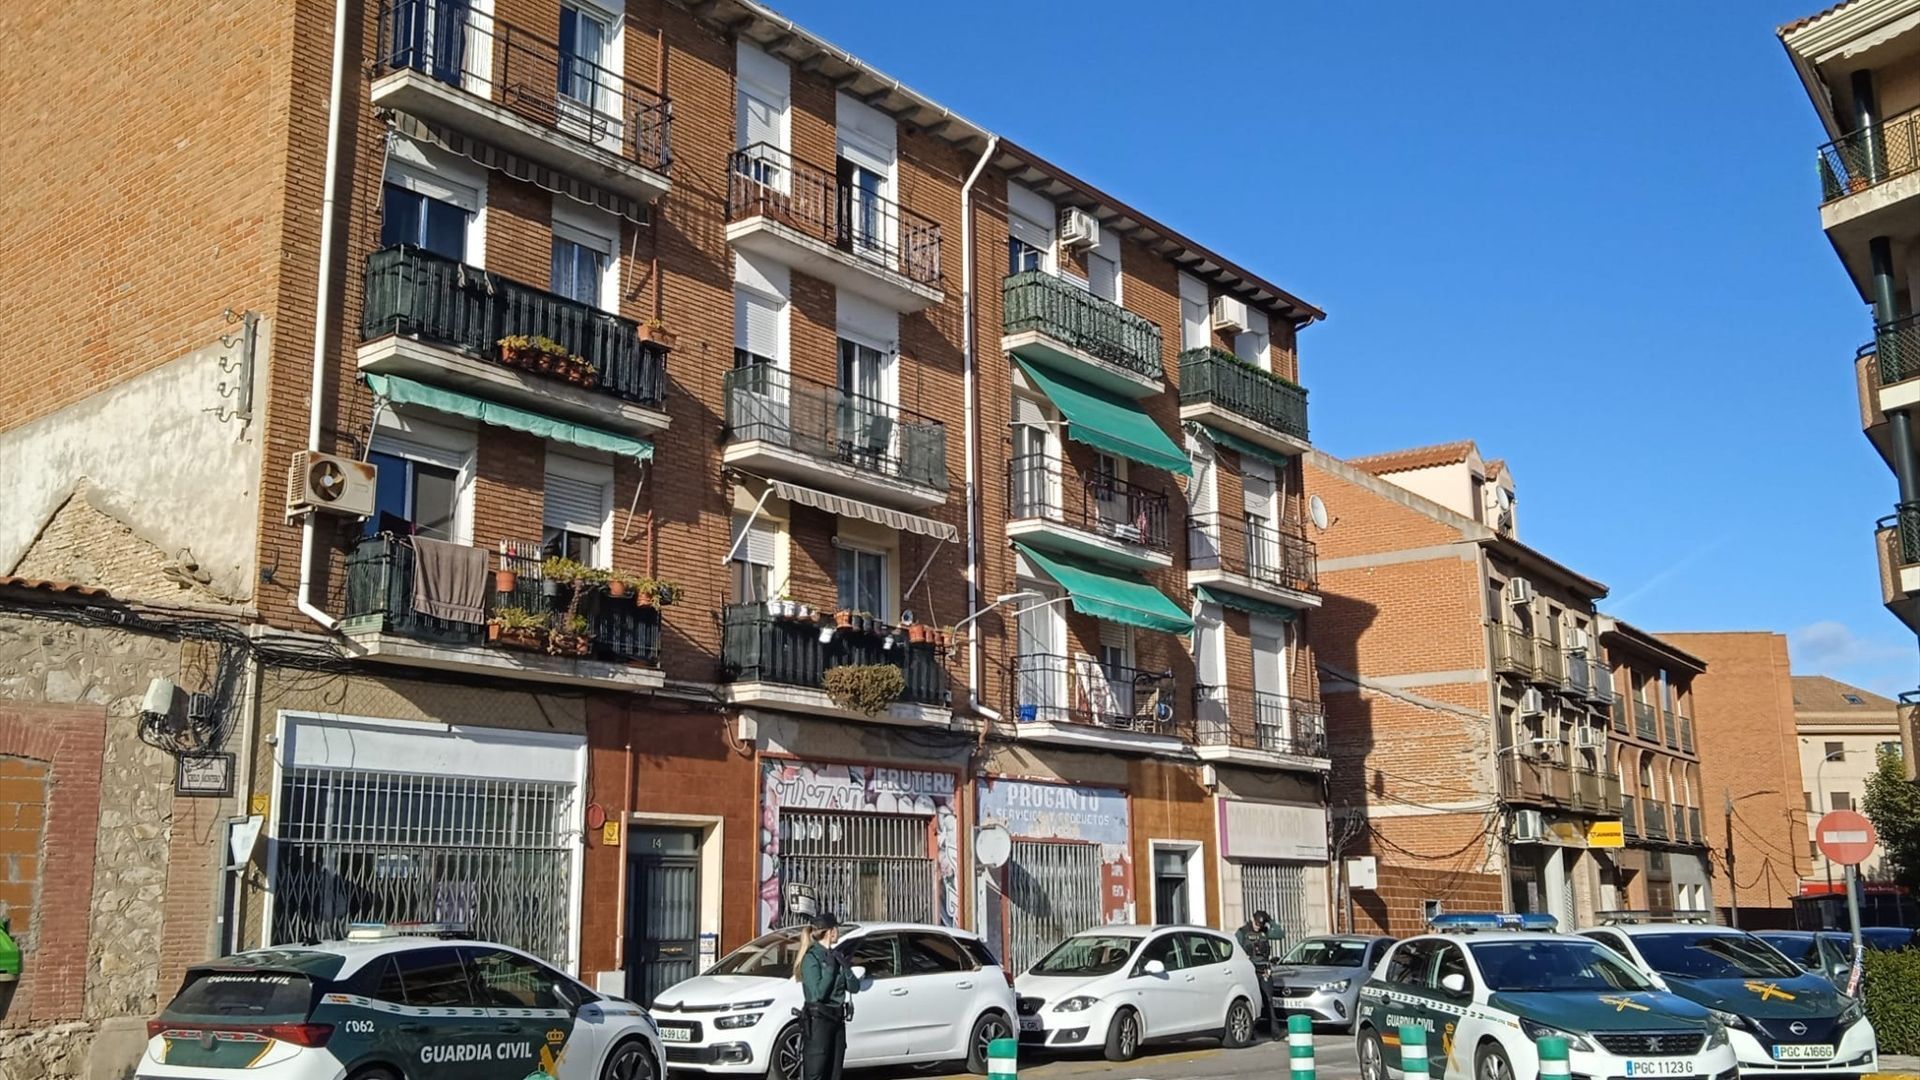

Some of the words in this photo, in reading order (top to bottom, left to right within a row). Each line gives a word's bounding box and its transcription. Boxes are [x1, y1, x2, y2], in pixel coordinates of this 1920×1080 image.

[651, 837, 663, 849] 14
[1386, 1014, 1415, 1027] GUARDIA
[1416, 1017, 1436, 1033] CIVIL
[420, 1043, 492, 1063] GUARDIA
[496, 1042, 532, 1060] CIVIL
[1780, 1047, 1801, 1057] PGC
[1634, 1062, 1655, 1074] PGC
[1658, 1061, 1684, 1074] 1123
